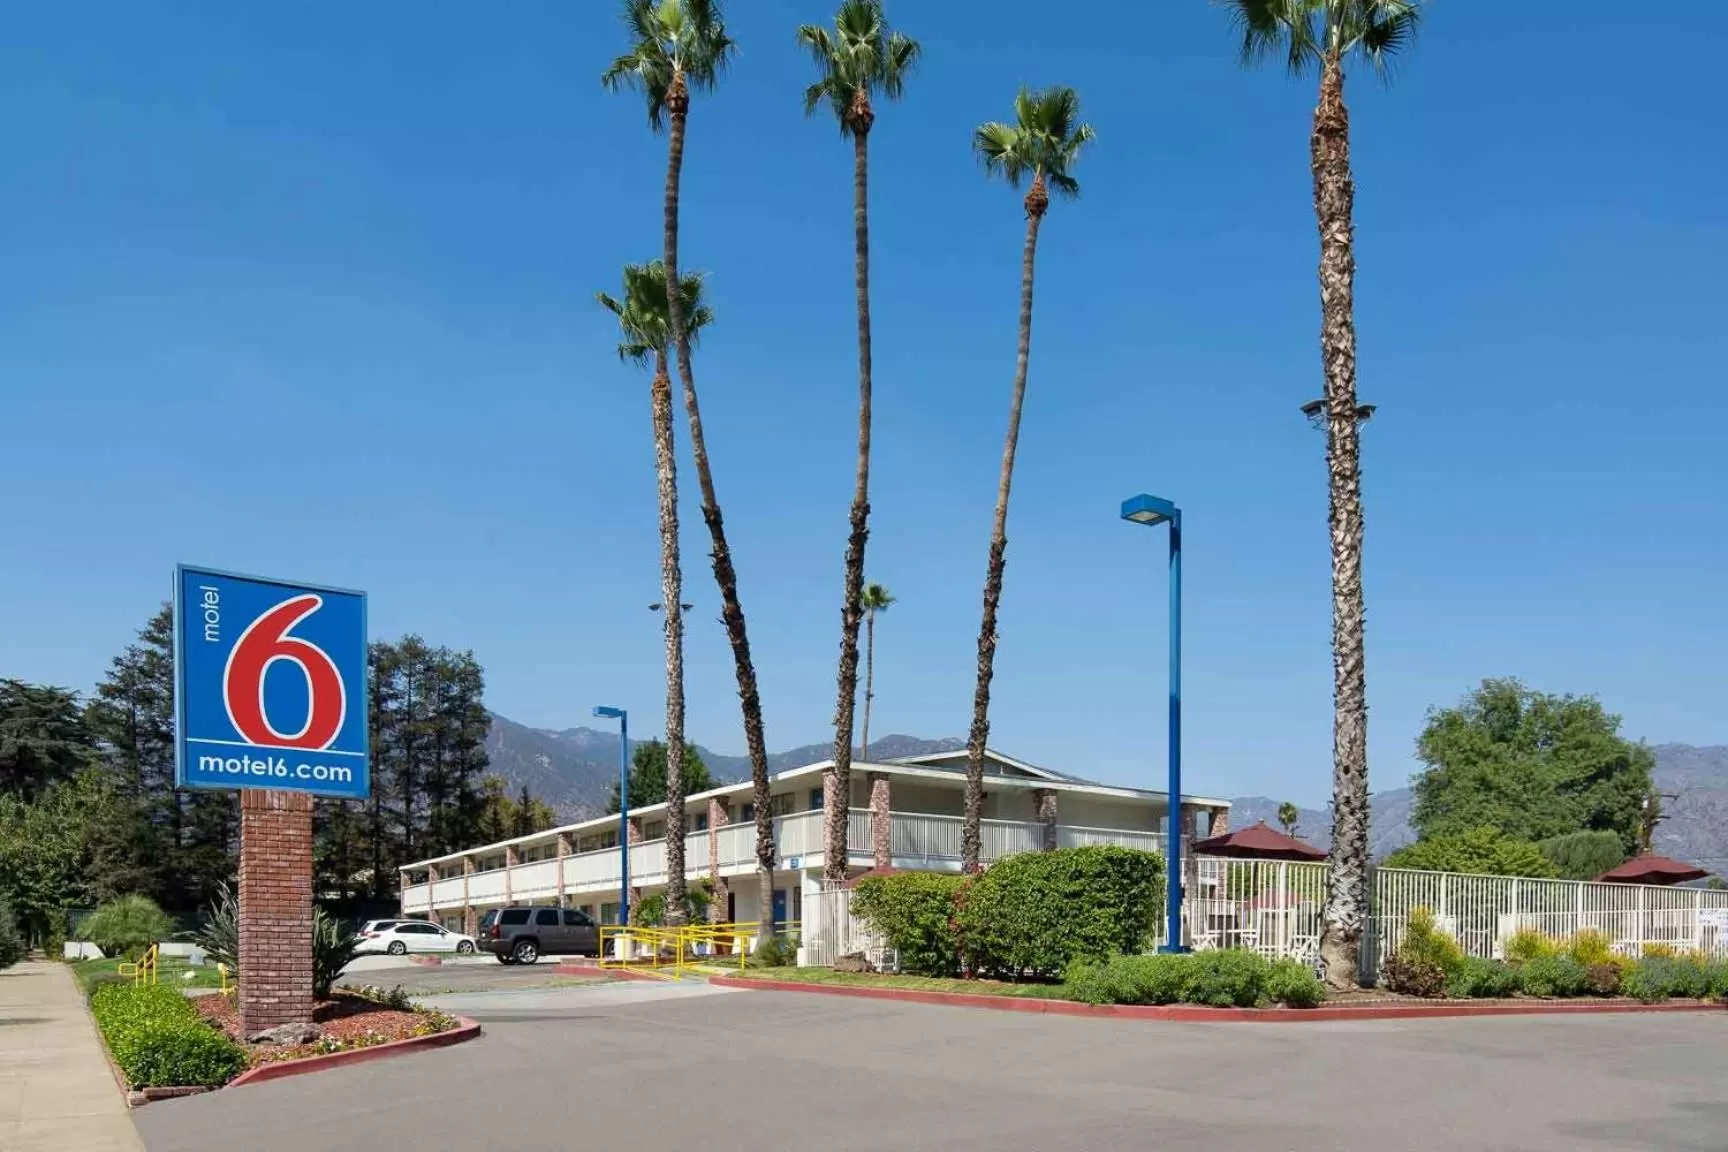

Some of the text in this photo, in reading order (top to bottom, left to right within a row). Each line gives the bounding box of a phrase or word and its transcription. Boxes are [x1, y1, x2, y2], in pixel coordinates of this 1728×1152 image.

[200, 585, 219, 642] motel
[223, 593, 346, 751] 6
[199, 755, 352, 782] motel6.com
